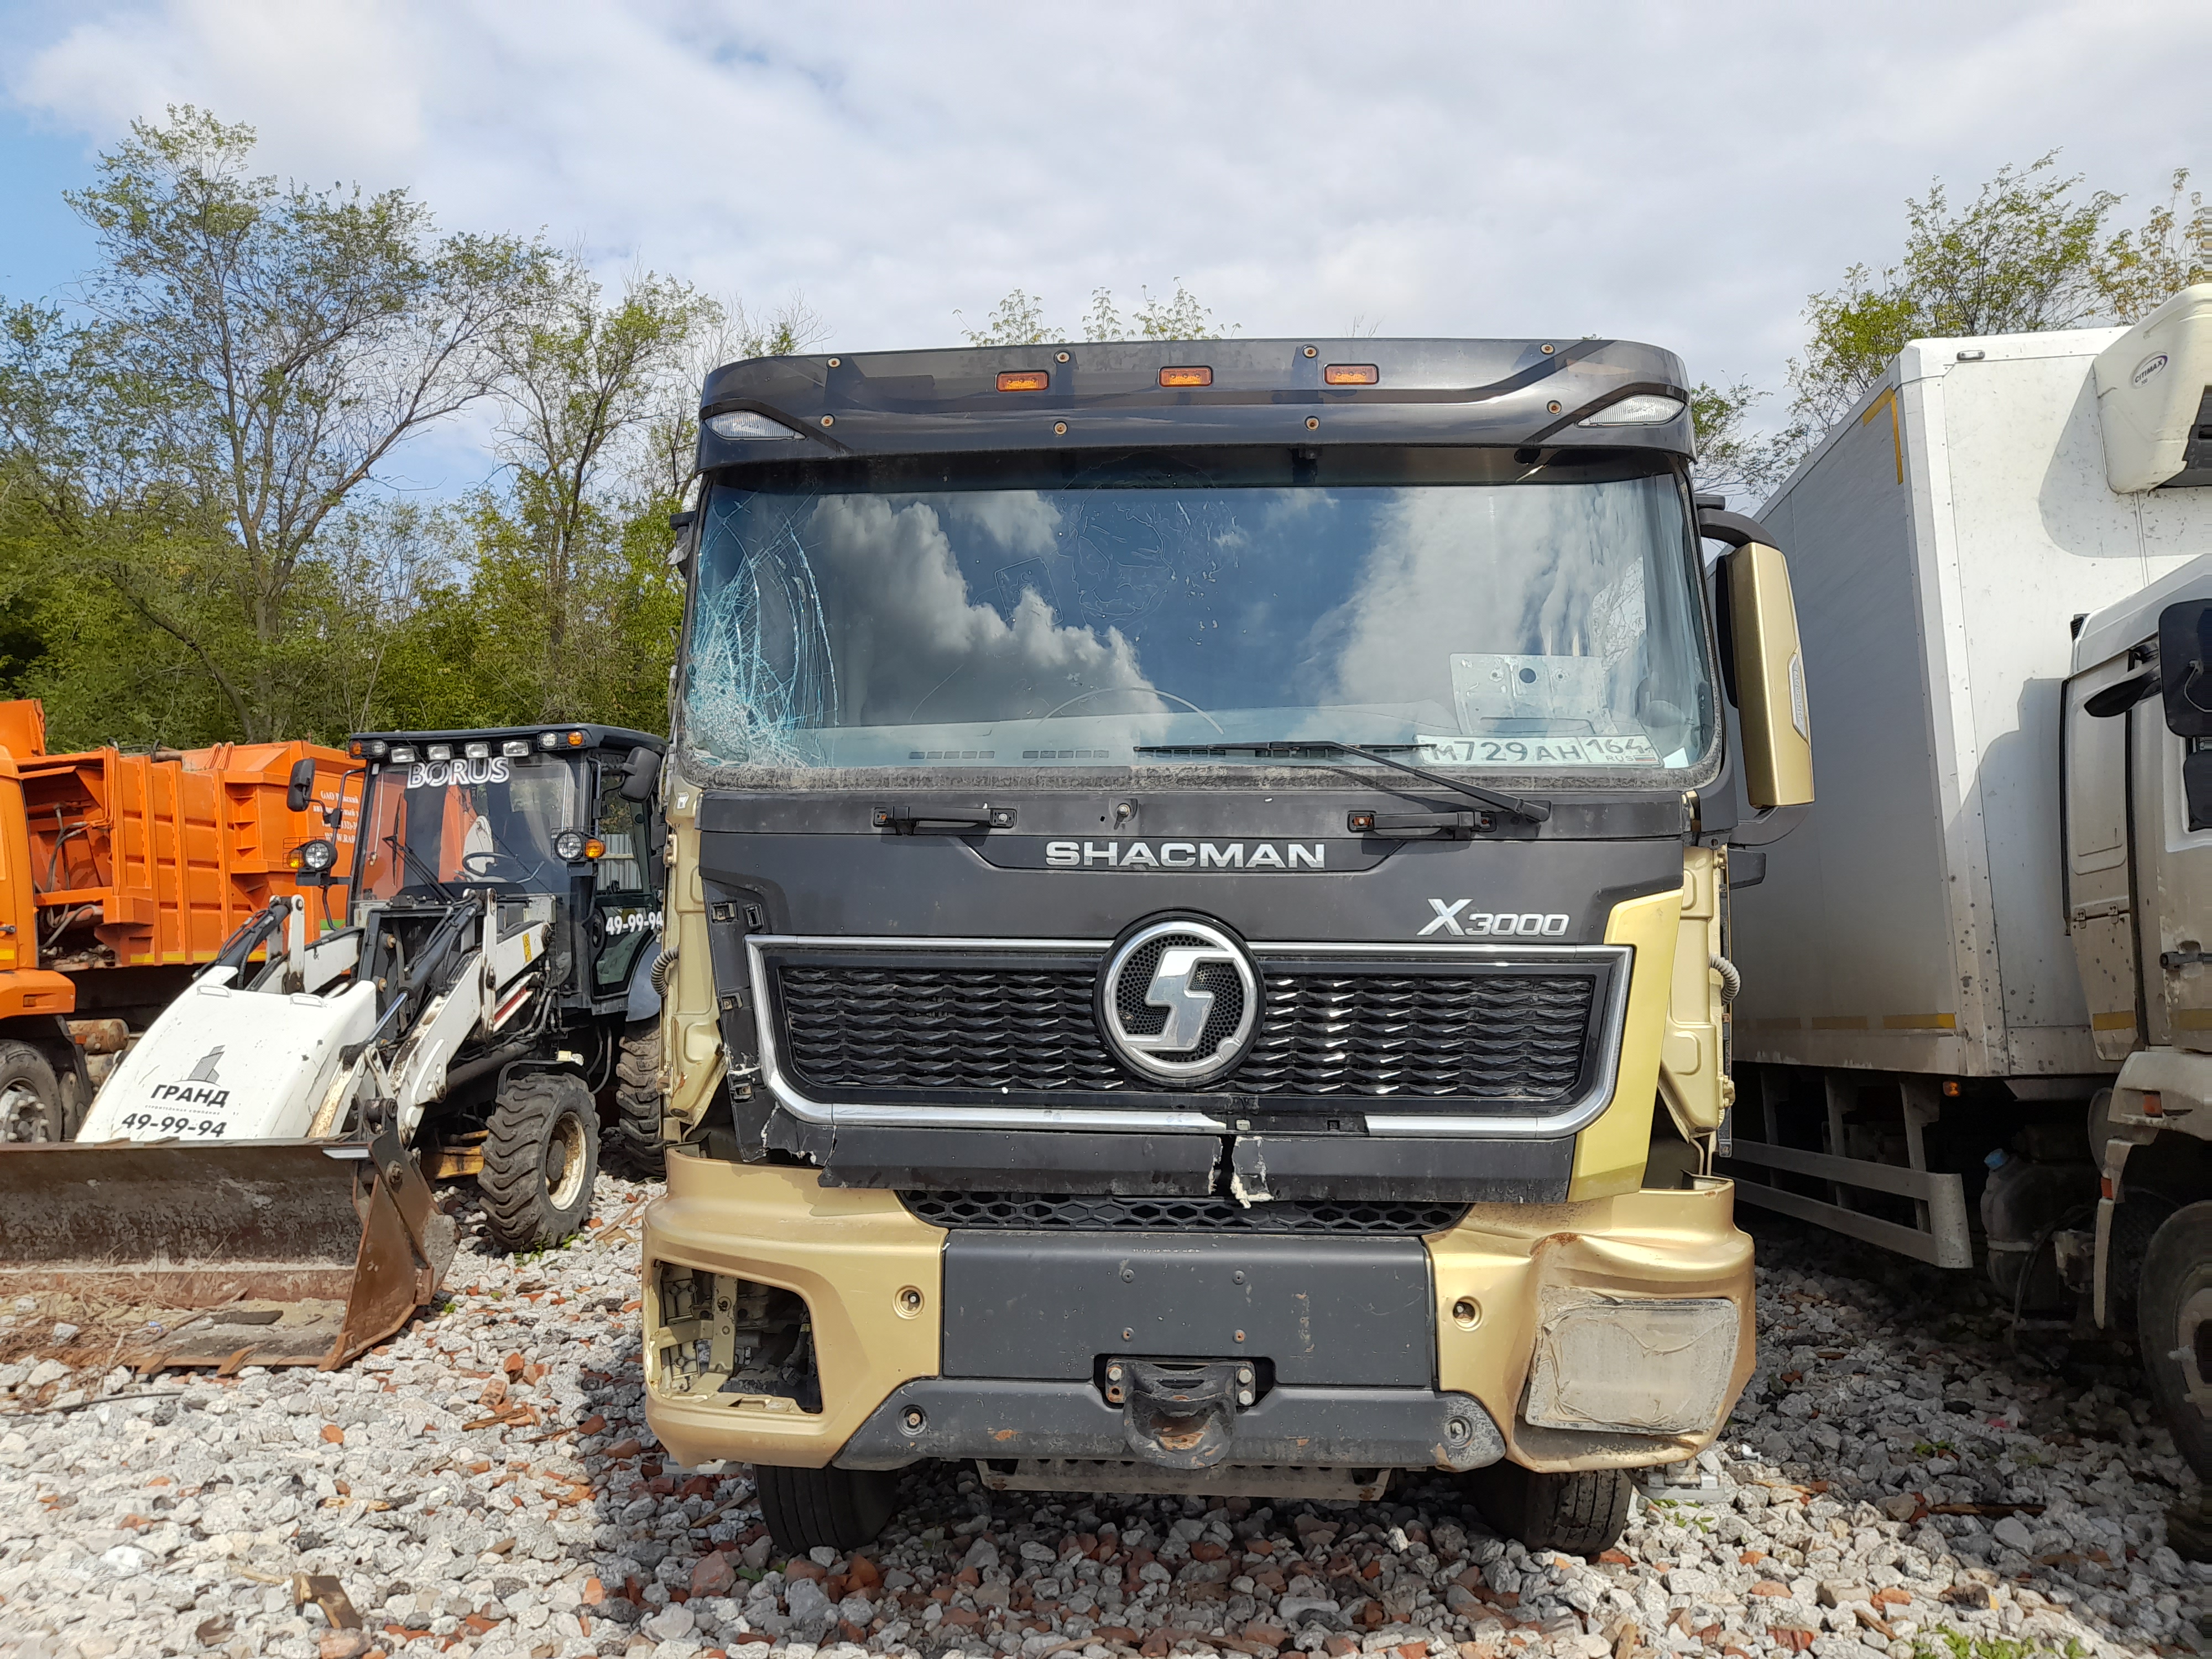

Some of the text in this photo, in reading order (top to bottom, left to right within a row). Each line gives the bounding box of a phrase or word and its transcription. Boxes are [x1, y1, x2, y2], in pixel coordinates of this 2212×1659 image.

[2135, 359, 2162, 383] CITIMAX
[1585, 738, 1646, 754] 164
[407, 757, 510, 789] BORUS
[1045, 841, 1326, 868] SHACMAN
[606, 911, 663, 935] 49-99-94
[1416, 898, 1571, 936] X3000
[150, 1084, 231, 1108] ГРАНД
[121, 1113, 227, 1138] 49-99-94
